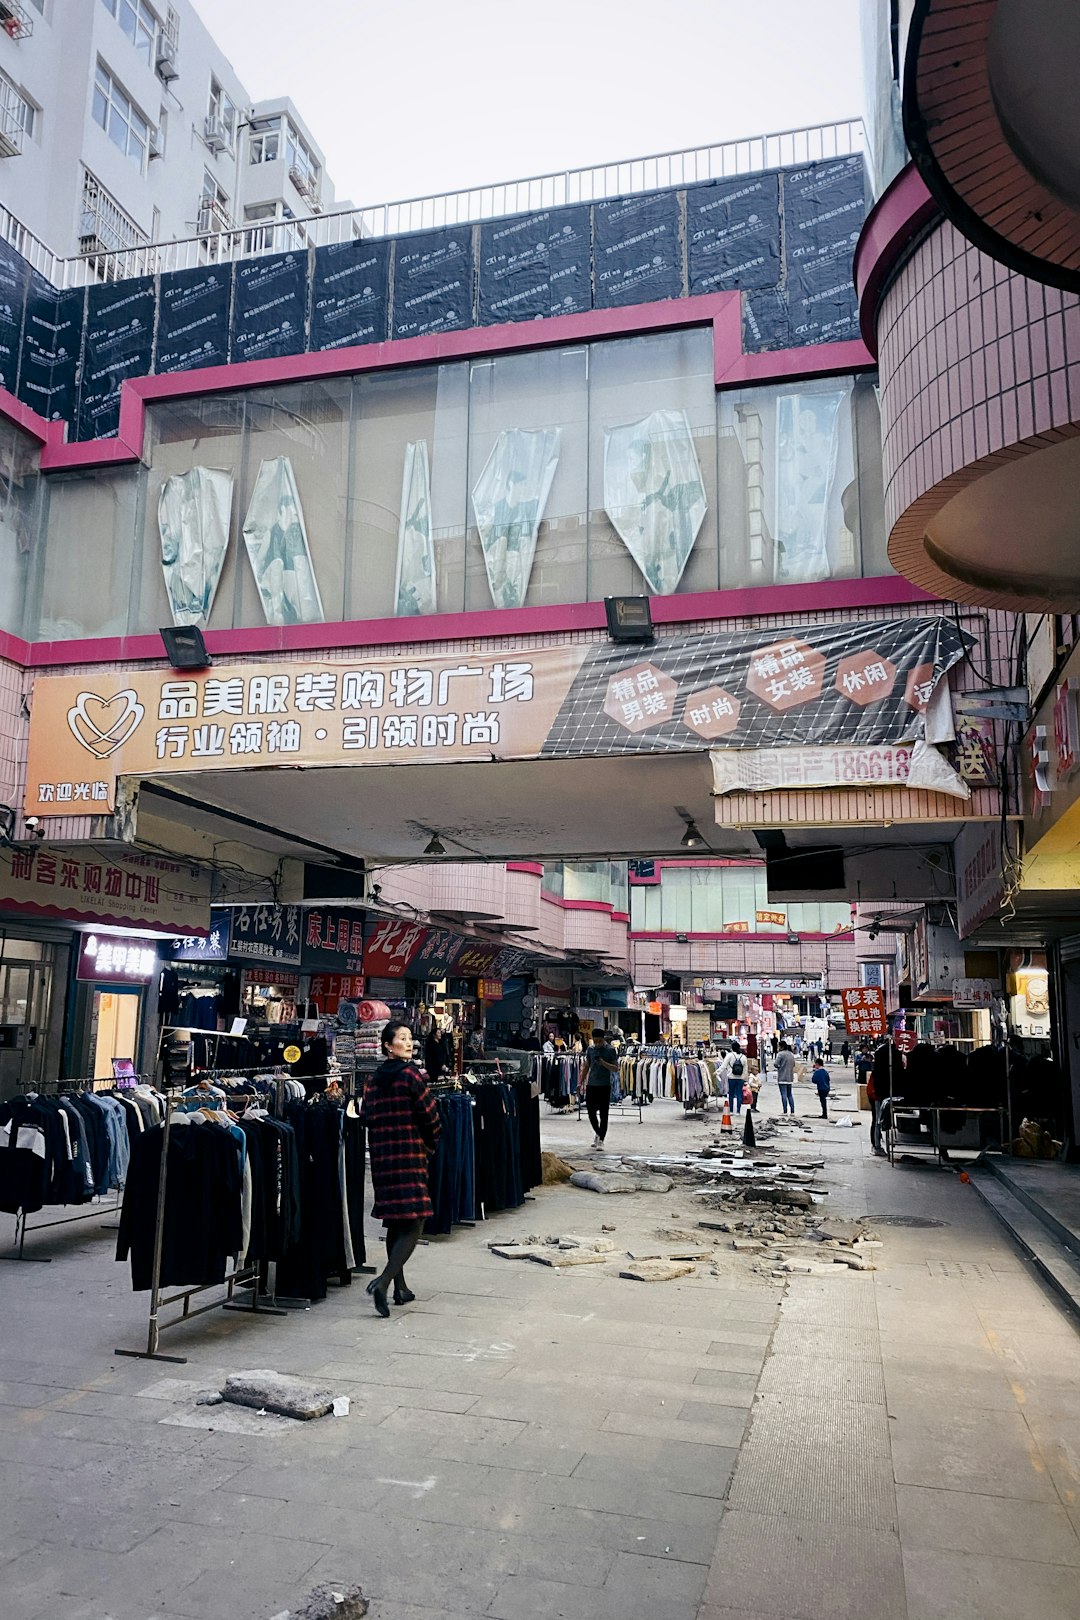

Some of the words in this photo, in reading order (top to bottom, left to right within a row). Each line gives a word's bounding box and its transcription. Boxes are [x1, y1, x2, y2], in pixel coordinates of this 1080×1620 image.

[754, 644, 805, 679] 精品
[158, 663, 535, 719] 品美服装购物广场
[611, 669, 659, 700] 精品
[765, 667, 816, 701] 女装
[842, 662, 888, 693] 休闲
[622, 692, 667, 725] 男装
[690, 697, 734, 726] 时尚
[832, 748, 912, 781] 186618
[37, 782, 110, 803] 欢迎光临
[108, 901, 137, 913] Shopping
[306, 911, 363, 955] 床上用品
[310, 976, 365, 998] 床上用品
[845, 989, 880, 1006] 修表
[847, 1008, 881, 1019] 配电池
[849, 1020, 883, 1032] 换表带
